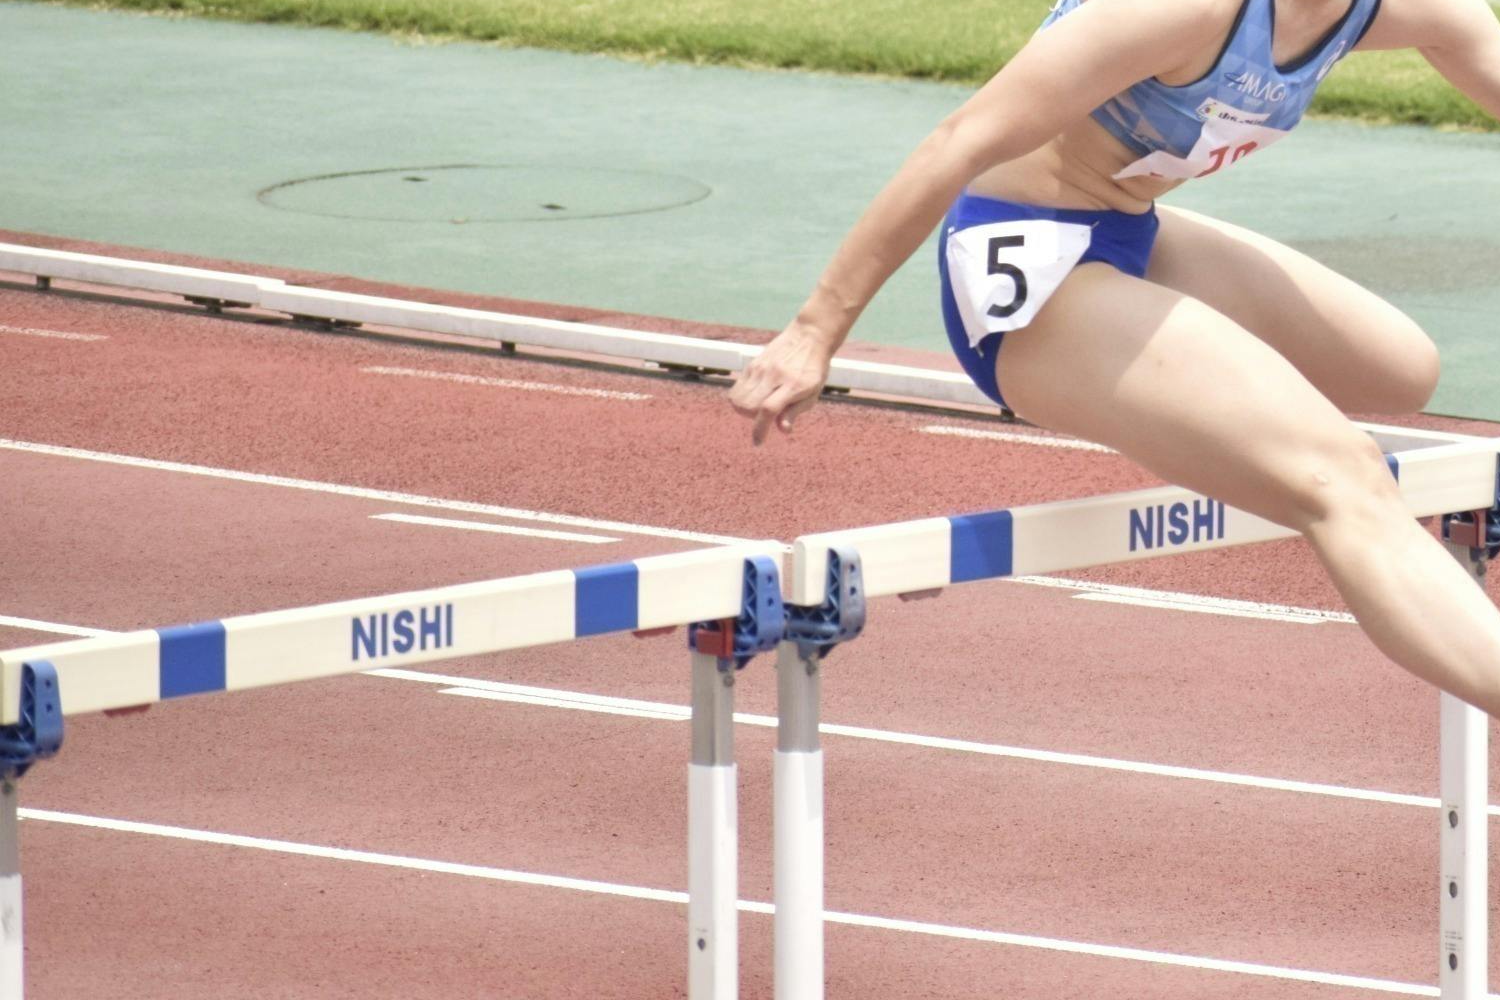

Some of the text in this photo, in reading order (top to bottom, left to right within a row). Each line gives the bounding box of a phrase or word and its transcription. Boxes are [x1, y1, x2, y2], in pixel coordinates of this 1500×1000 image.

[987, 235, 1028, 318] 5
[1129, 499, 1225, 552] NISHI
[352, 603, 454, 661] NISHI
